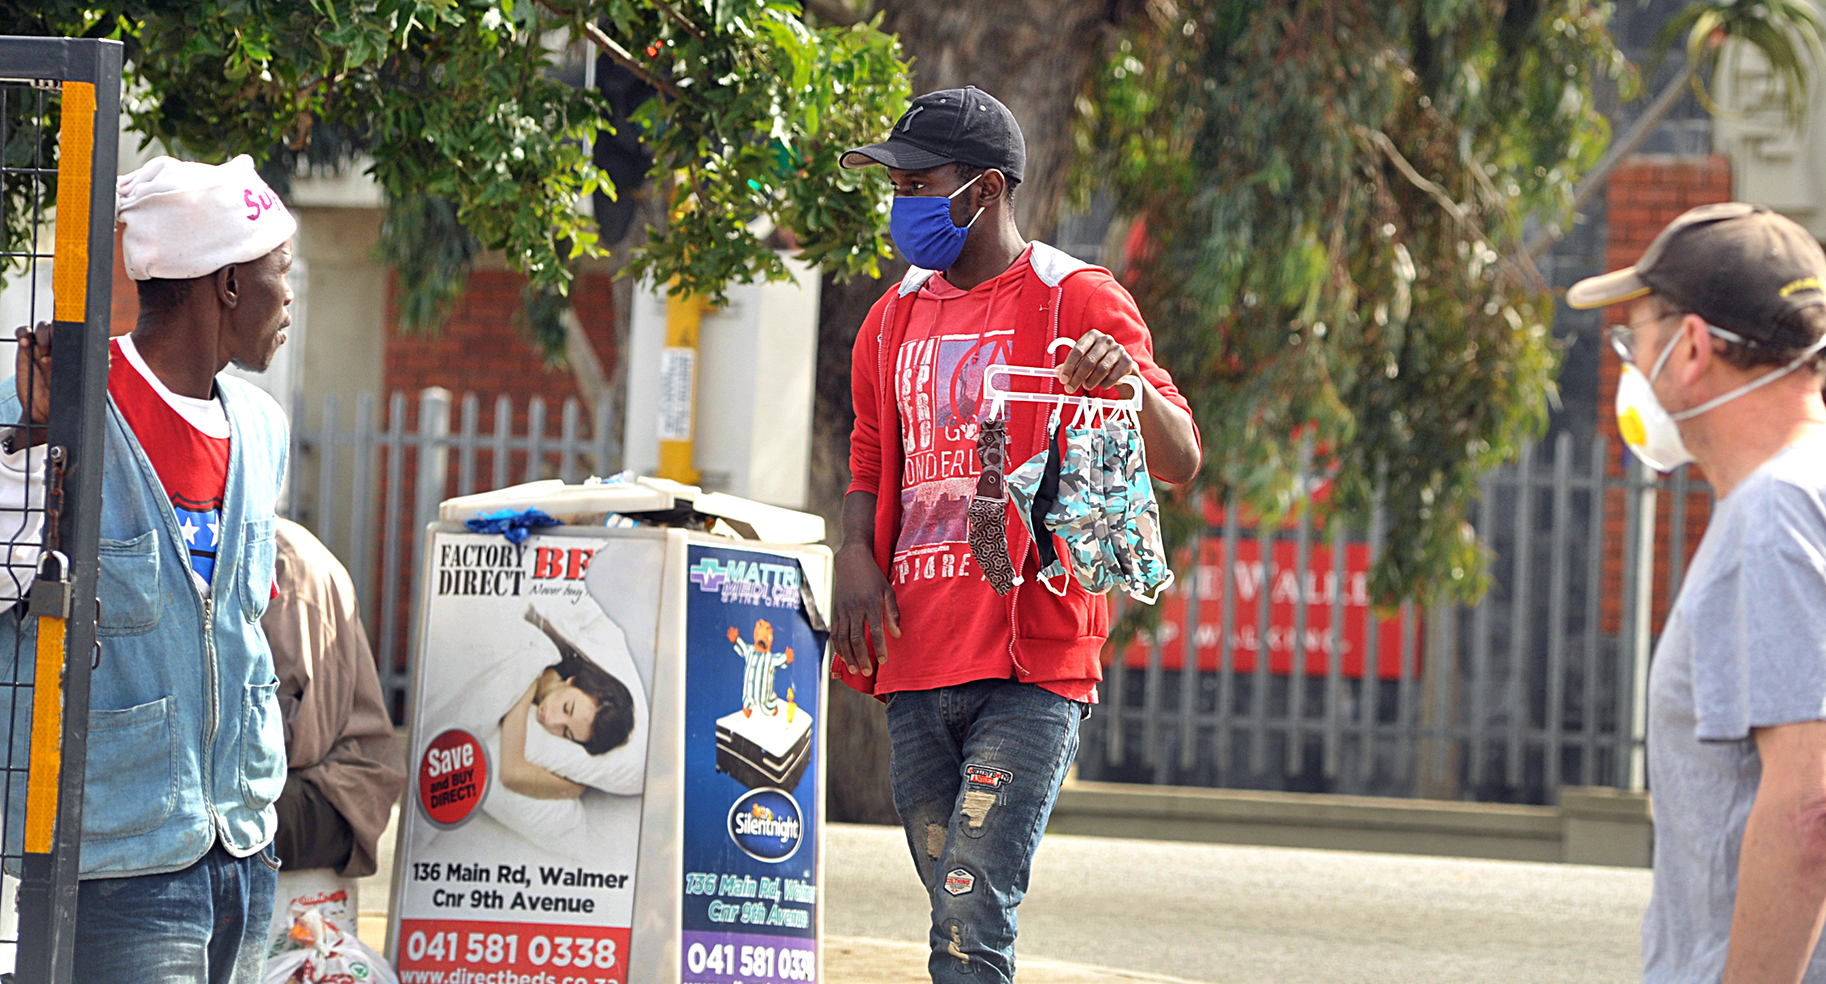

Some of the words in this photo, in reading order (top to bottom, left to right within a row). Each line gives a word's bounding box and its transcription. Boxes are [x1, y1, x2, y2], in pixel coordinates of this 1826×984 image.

[440, 544, 528, 568] FACTORY
[531, 546, 595, 581] BE
[438, 569, 526, 597] DIRECT
[427, 742, 475, 777] Save
[430, 776, 450, 794] and
[451, 768, 475, 788] BUY
[430, 783, 477, 809] DIRECT!
[735, 812, 800, 843] Silentnight
[412, 862, 441, 882] 136
[446, 862, 491, 883] Main
[497, 865, 532, 888] Rd,
[539, 866, 629, 889] Walmer
[686, 871, 717, 896] 136
[718, 874, 758, 898] Main
[758, 876, 781, 903] Rd,
[432, 889, 465, 908] Cnr
[470, 889, 504, 910] 9th
[510, 891, 596, 913] Avenue
[708, 900, 740, 923] Cnr
[740, 902, 767, 925] 9th
[766, 903, 810, 929] Avenue
[406, 930, 459, 962] 041
[465, 932, 519, 965] 581
[527, 935, 617, 969] 0338
[687, 942, 736, 976] 041
[739, 945, 775, 978] 581
[400, 967, 619, 984] www.directbedscoza
